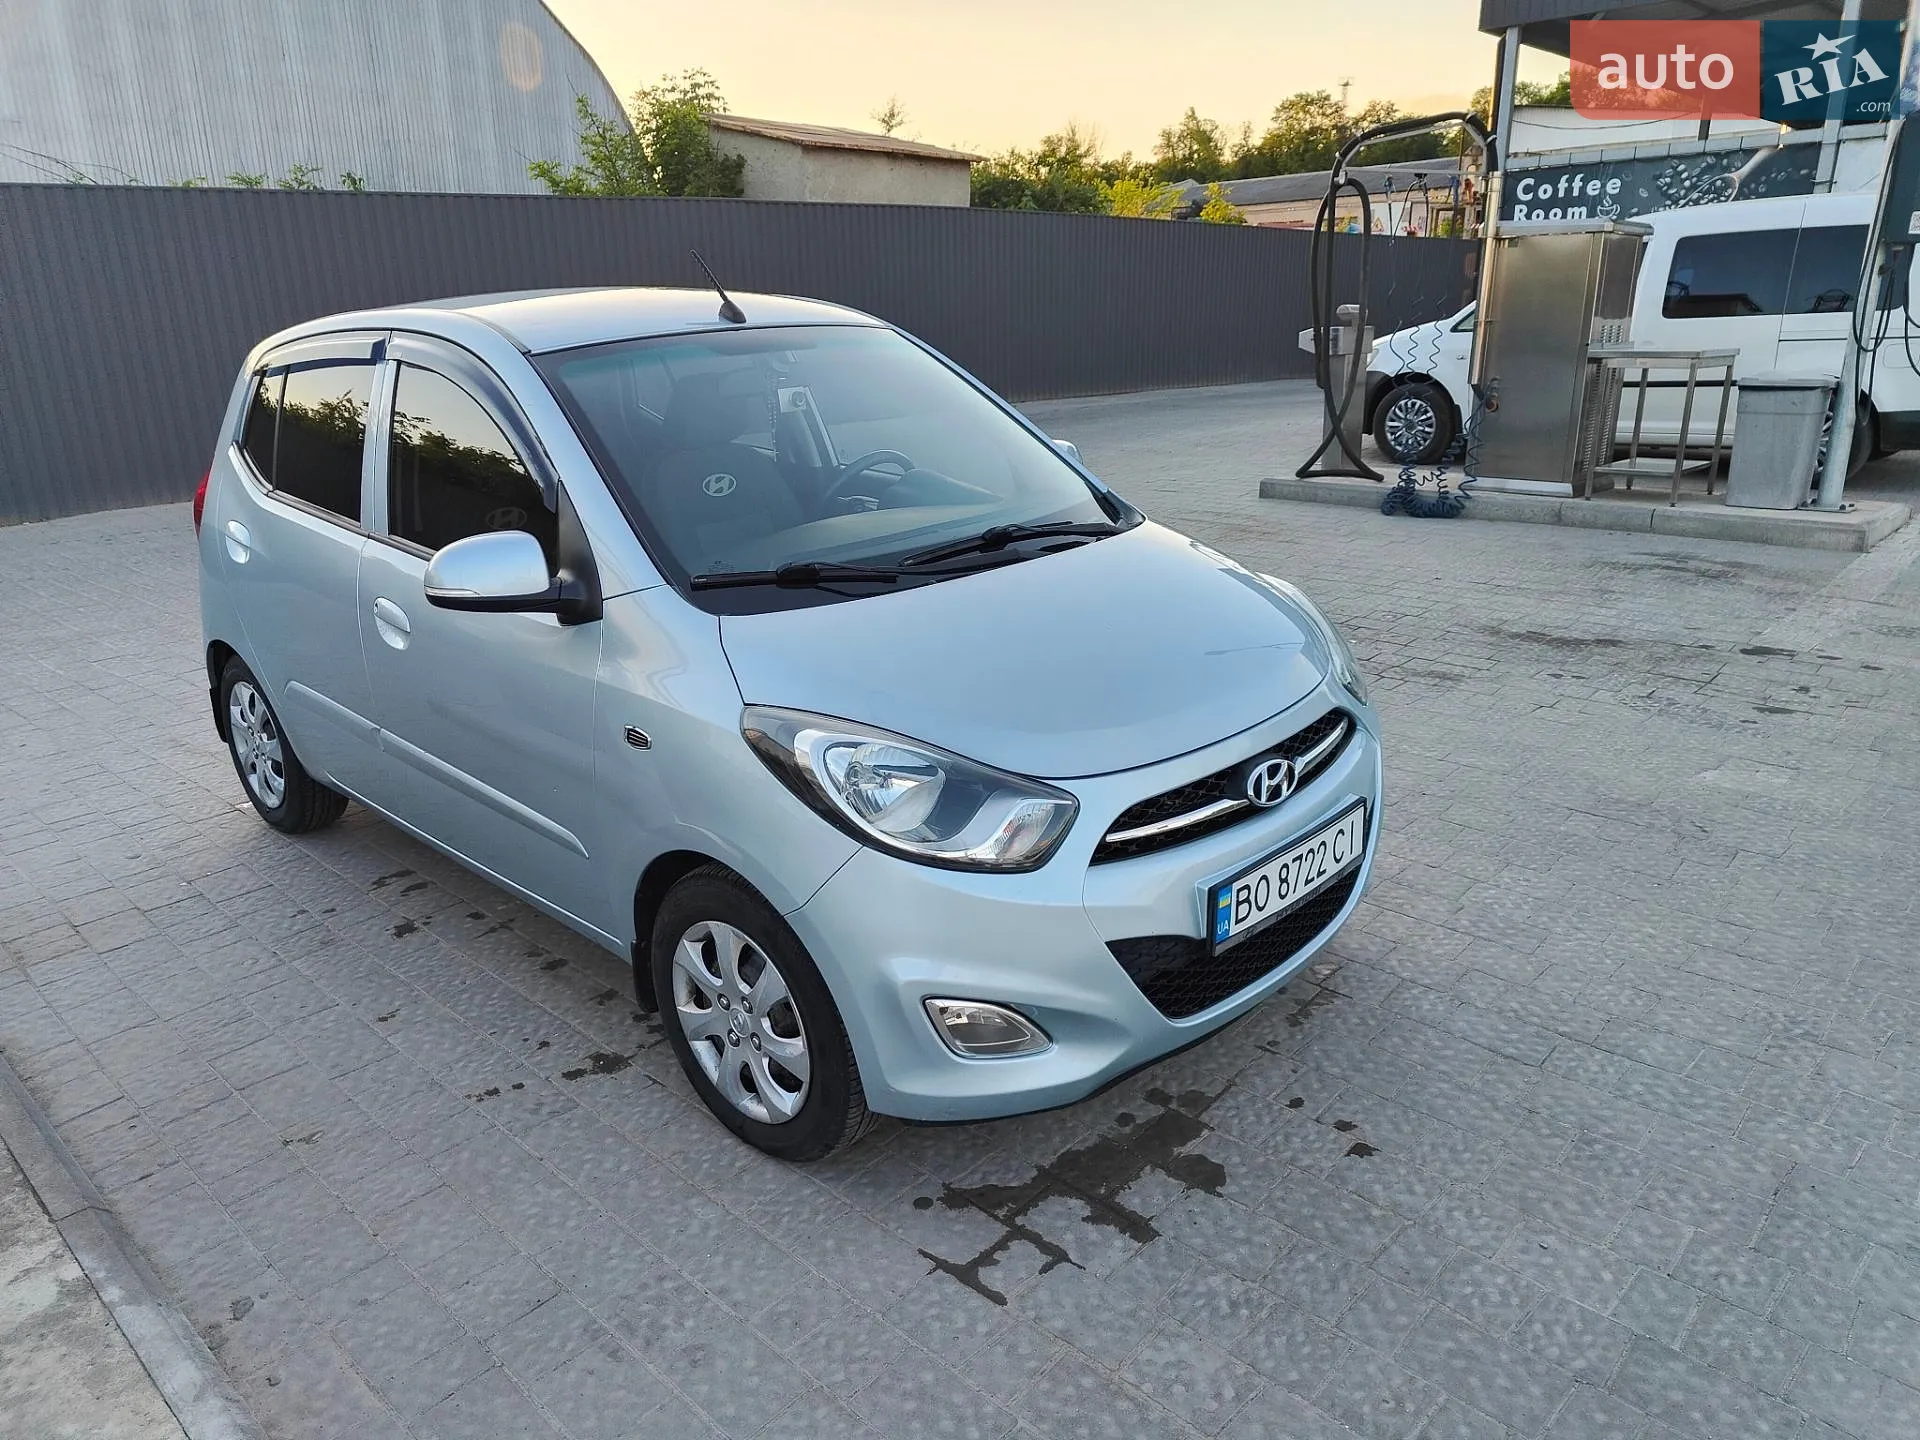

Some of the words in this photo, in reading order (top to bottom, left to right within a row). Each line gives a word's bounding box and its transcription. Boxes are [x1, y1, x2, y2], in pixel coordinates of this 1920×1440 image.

[1516, 173, 1622, 201] Coffee
[1513, 204, 1588, 222] Room
[1234, 874, 1270, 926] BO
[1278, 840, 1328, 900] 8722
[1332, 820, 1355, 864] CI
[1217, 919, 1230, 935] UA
